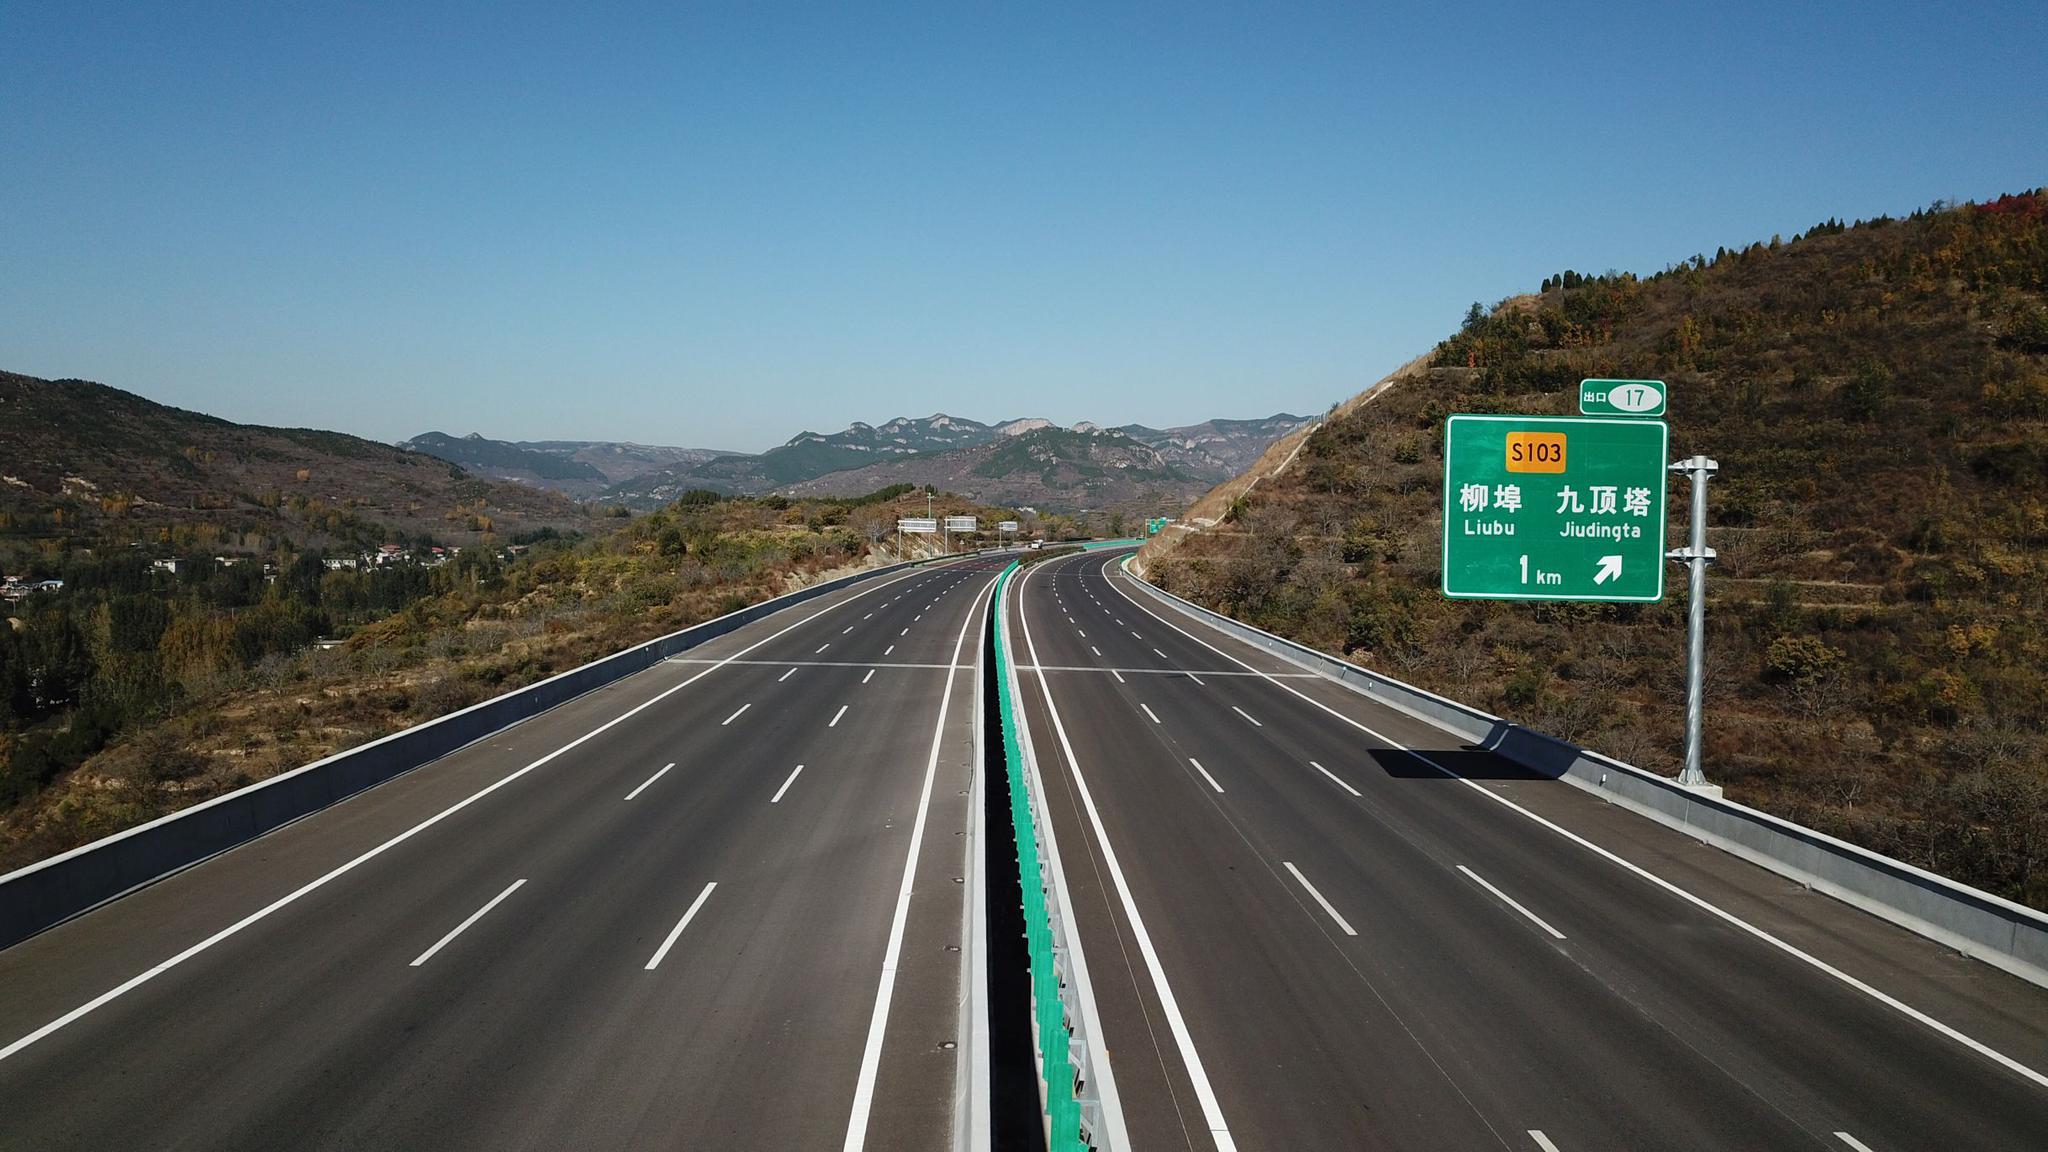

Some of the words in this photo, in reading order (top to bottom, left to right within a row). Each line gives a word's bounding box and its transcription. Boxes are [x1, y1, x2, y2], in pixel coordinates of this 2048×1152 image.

[1583, 392, 1607, 403] 出口
[1625, 389, 1645, 407] 17
[1511, 442, 1562, 463] S103
[1459, 483, 1523, 514] 柳埠
[1556, 485, 1652, 517] 九顶塔
[1464, 520, 1515, 536] Liubu
[1559, 521, 1642, 542] Jiudingta
[1519, 554, 1529, 585] 1
[1536, 569, 1562, 586] km
